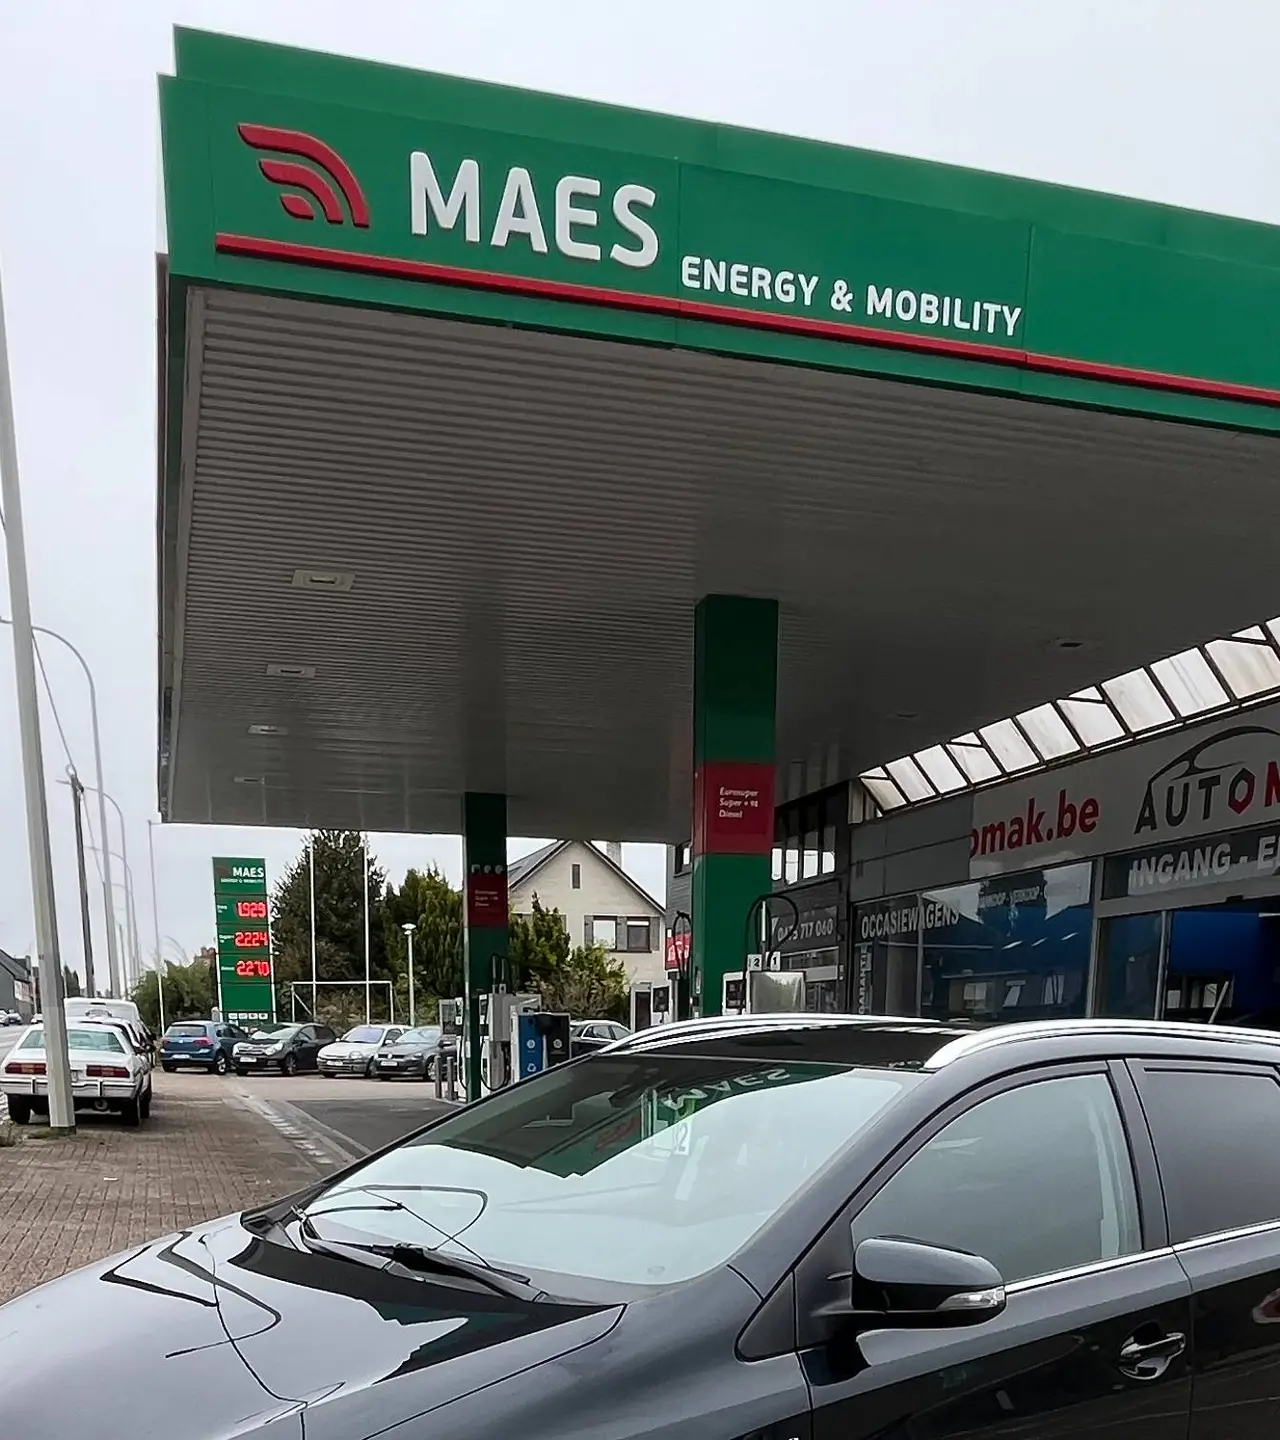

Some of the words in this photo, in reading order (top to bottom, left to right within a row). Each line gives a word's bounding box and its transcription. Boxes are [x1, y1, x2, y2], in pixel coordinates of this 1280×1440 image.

[409, 151, 660, 269] MAES
[681, 255, 819, 307] ENERGY
[829, 280, 854, 313] &
[866, 284, 1023, 338] MOBILITY
[232, 867, 265, 878] MAES
[1129, 842, 1231, 889] INGANG
[862, 904, 959, 939] OCCASIEWAGENS
[753, 957, 761, 968] 2
